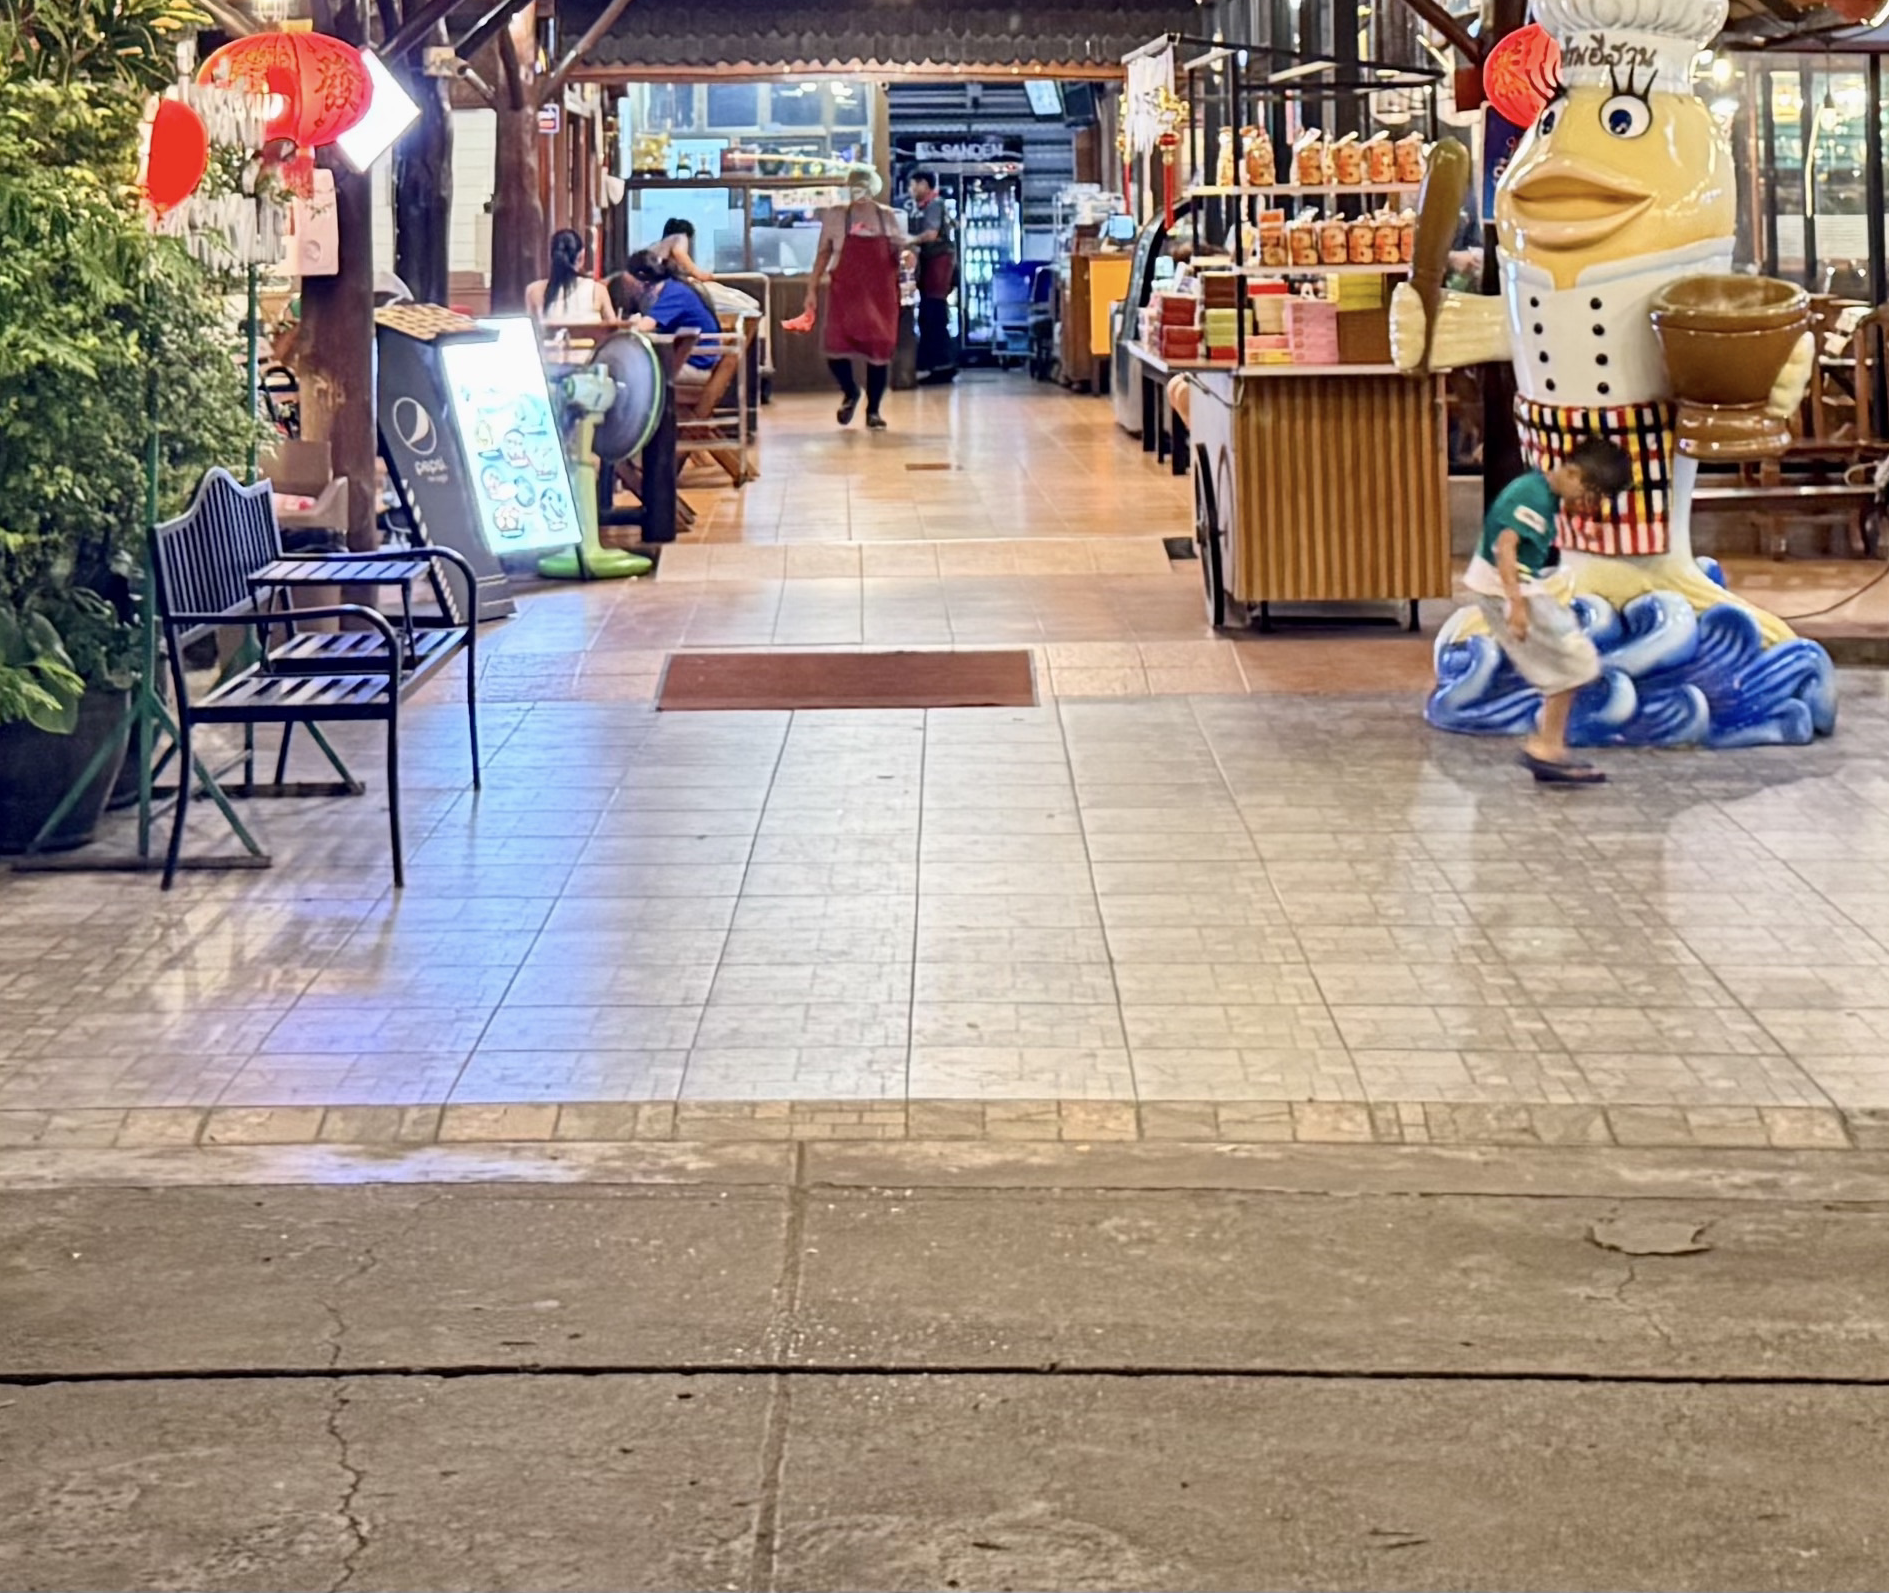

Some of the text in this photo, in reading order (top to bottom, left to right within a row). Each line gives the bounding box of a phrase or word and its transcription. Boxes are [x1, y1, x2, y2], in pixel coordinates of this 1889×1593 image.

[1560, 32, 1658, 67] ้านอีสาน
[940, 142, 1004, 161] SANDEN
